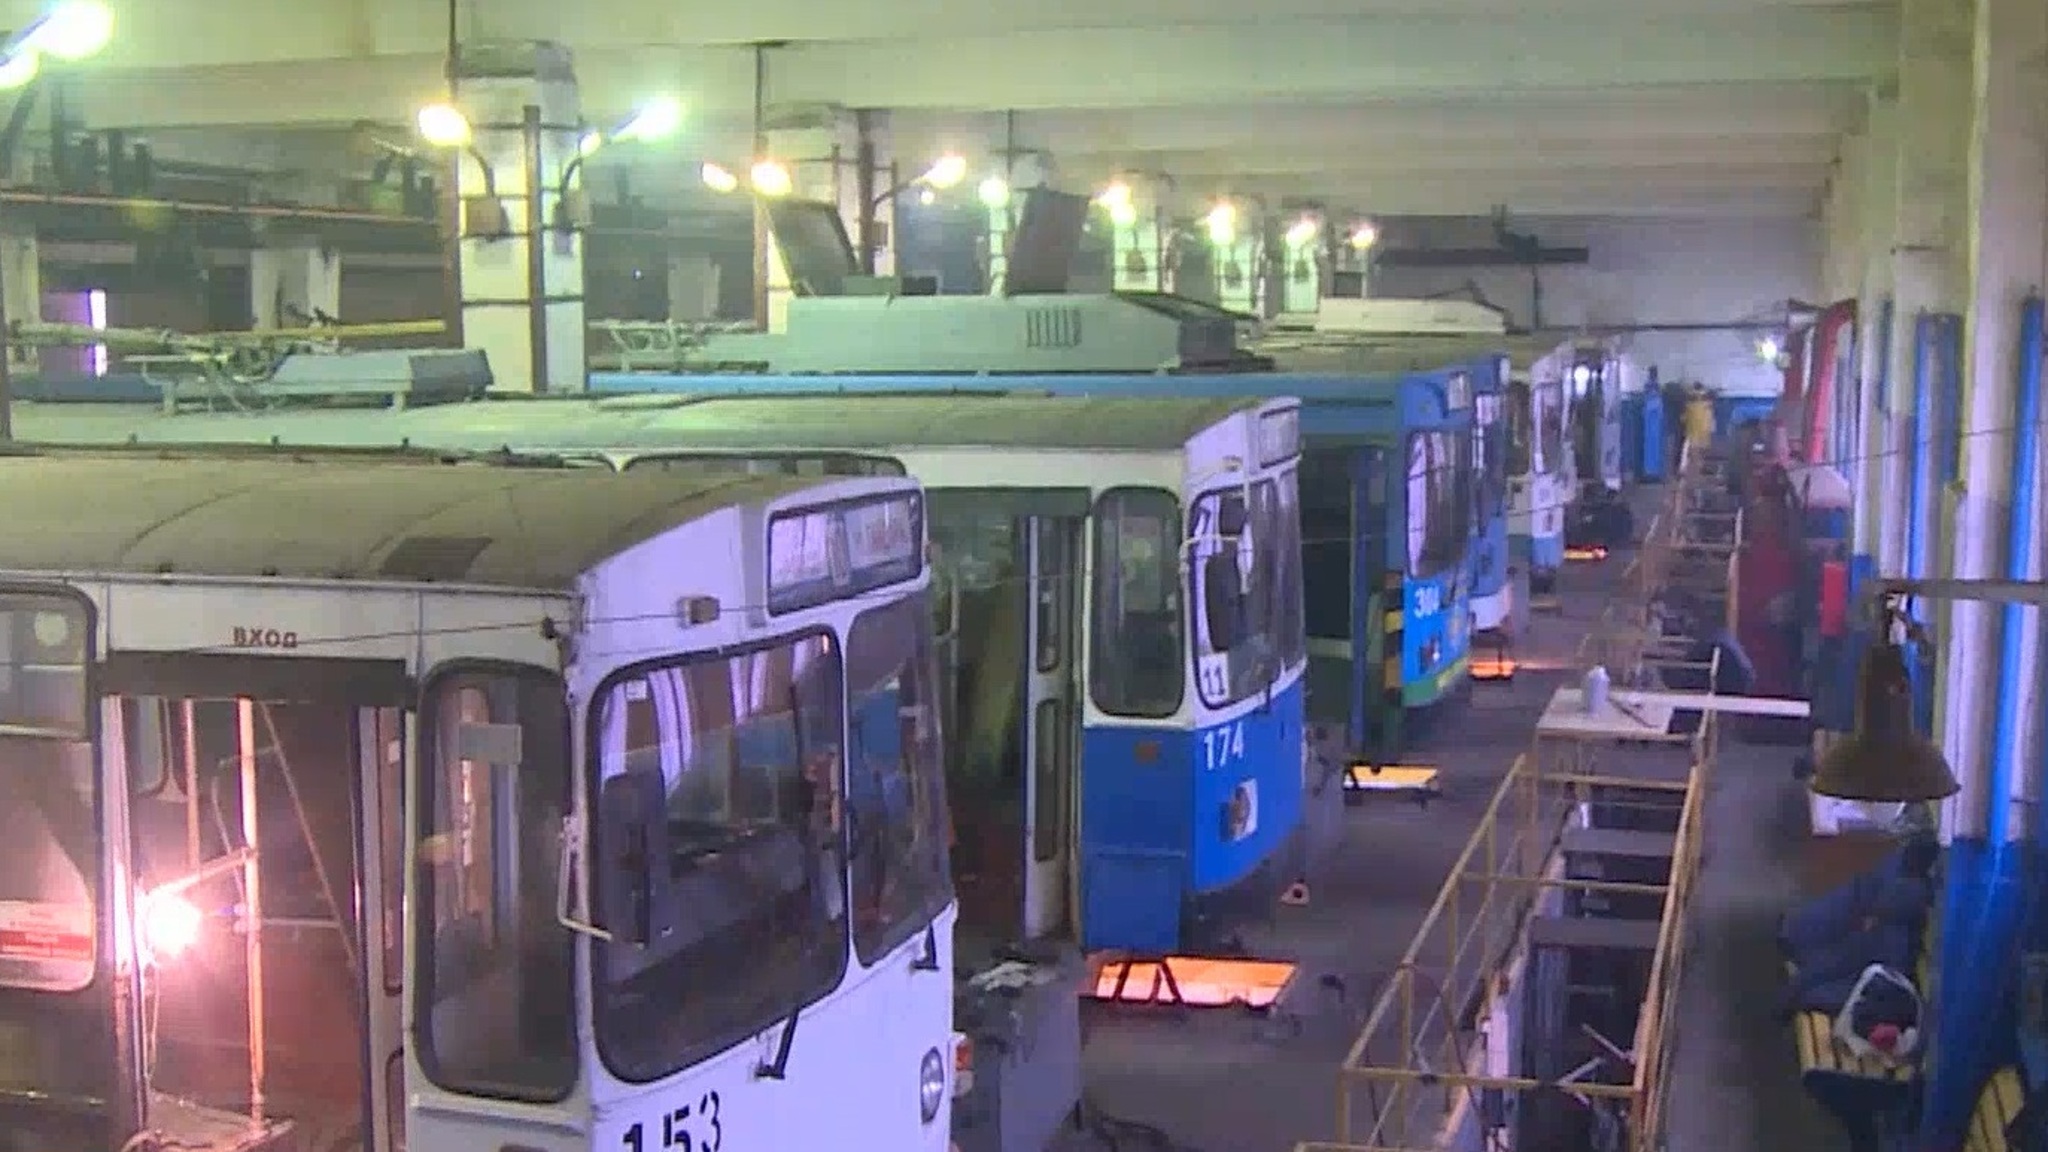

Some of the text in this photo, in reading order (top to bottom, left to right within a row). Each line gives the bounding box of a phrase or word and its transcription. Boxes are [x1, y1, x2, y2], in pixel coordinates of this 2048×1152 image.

[233, 626, 298, 648] ВХОД
[1204, 666, 1225, 695] 11
[1204, 721, 1244, 770] 174
